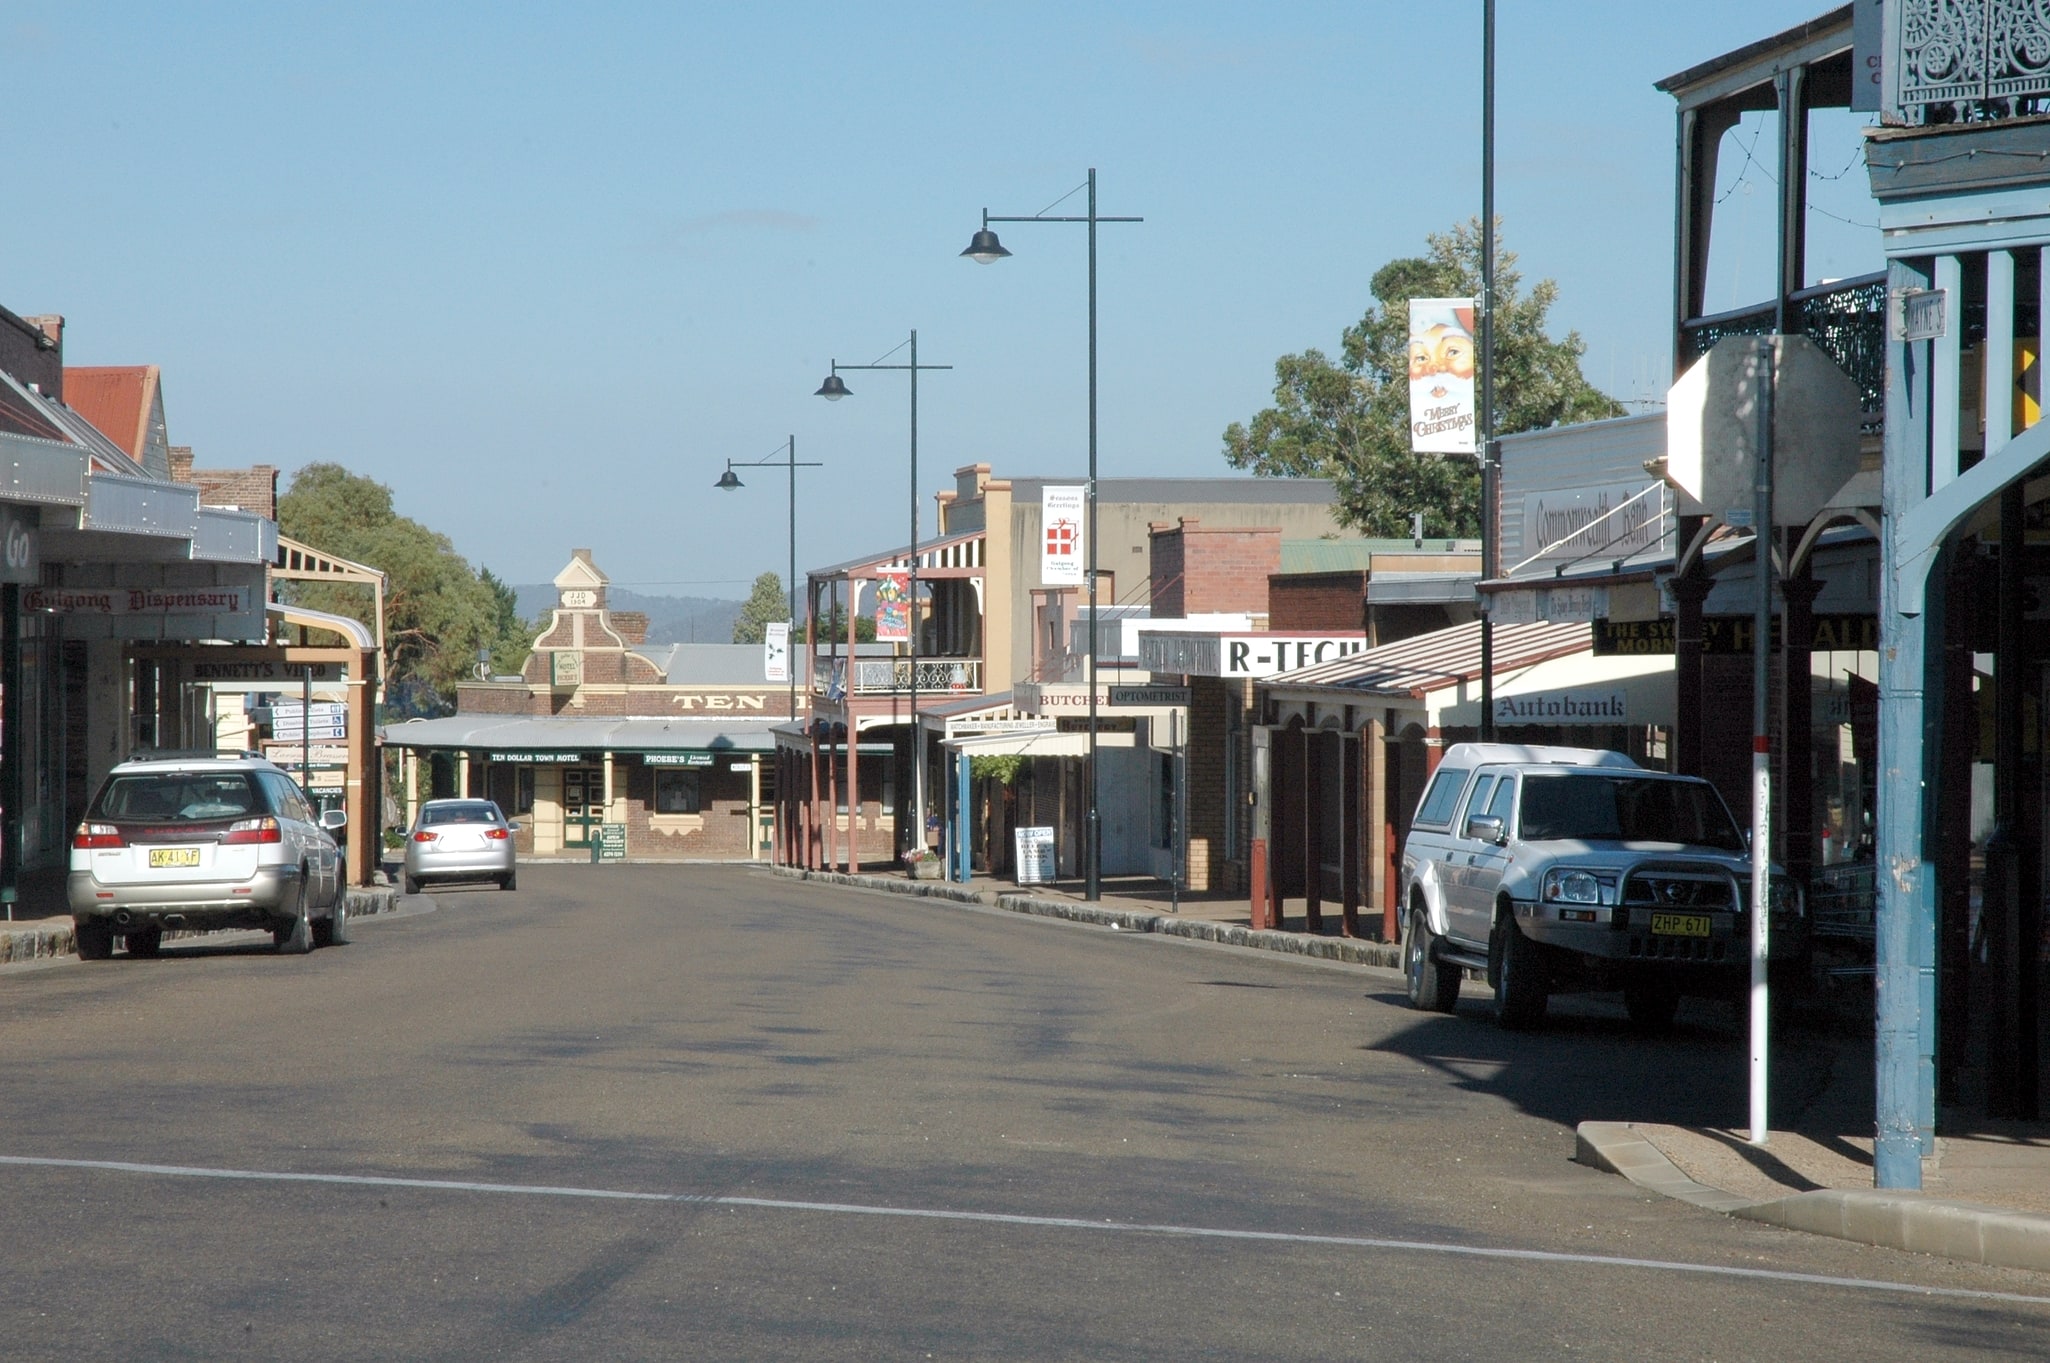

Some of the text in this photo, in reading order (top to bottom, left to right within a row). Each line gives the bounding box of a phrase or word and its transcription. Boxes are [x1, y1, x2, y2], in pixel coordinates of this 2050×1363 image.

[1424, 403, 1460, 420] MERRY
[1413, 413, 1473, 437] CHRISTMAS
[1536, 485, 1649, 548] Commonwealth Bank
[24, 589, 239, 612] Gulgong Dispensary
[1608, 623, 1640, 638] THE
[194, 663, 274, 678] BENNETT'S
[673, 695, 766, 709] TEN
[1115, 689, 1187, 702] OPTOMETRIST
[1498, 696, 1624, 716] Autobank
[492, 754, 579, 762] TEN DOLLAR TOWN MOTEL
[645, 755, 685, 763] PHOEBE'S
